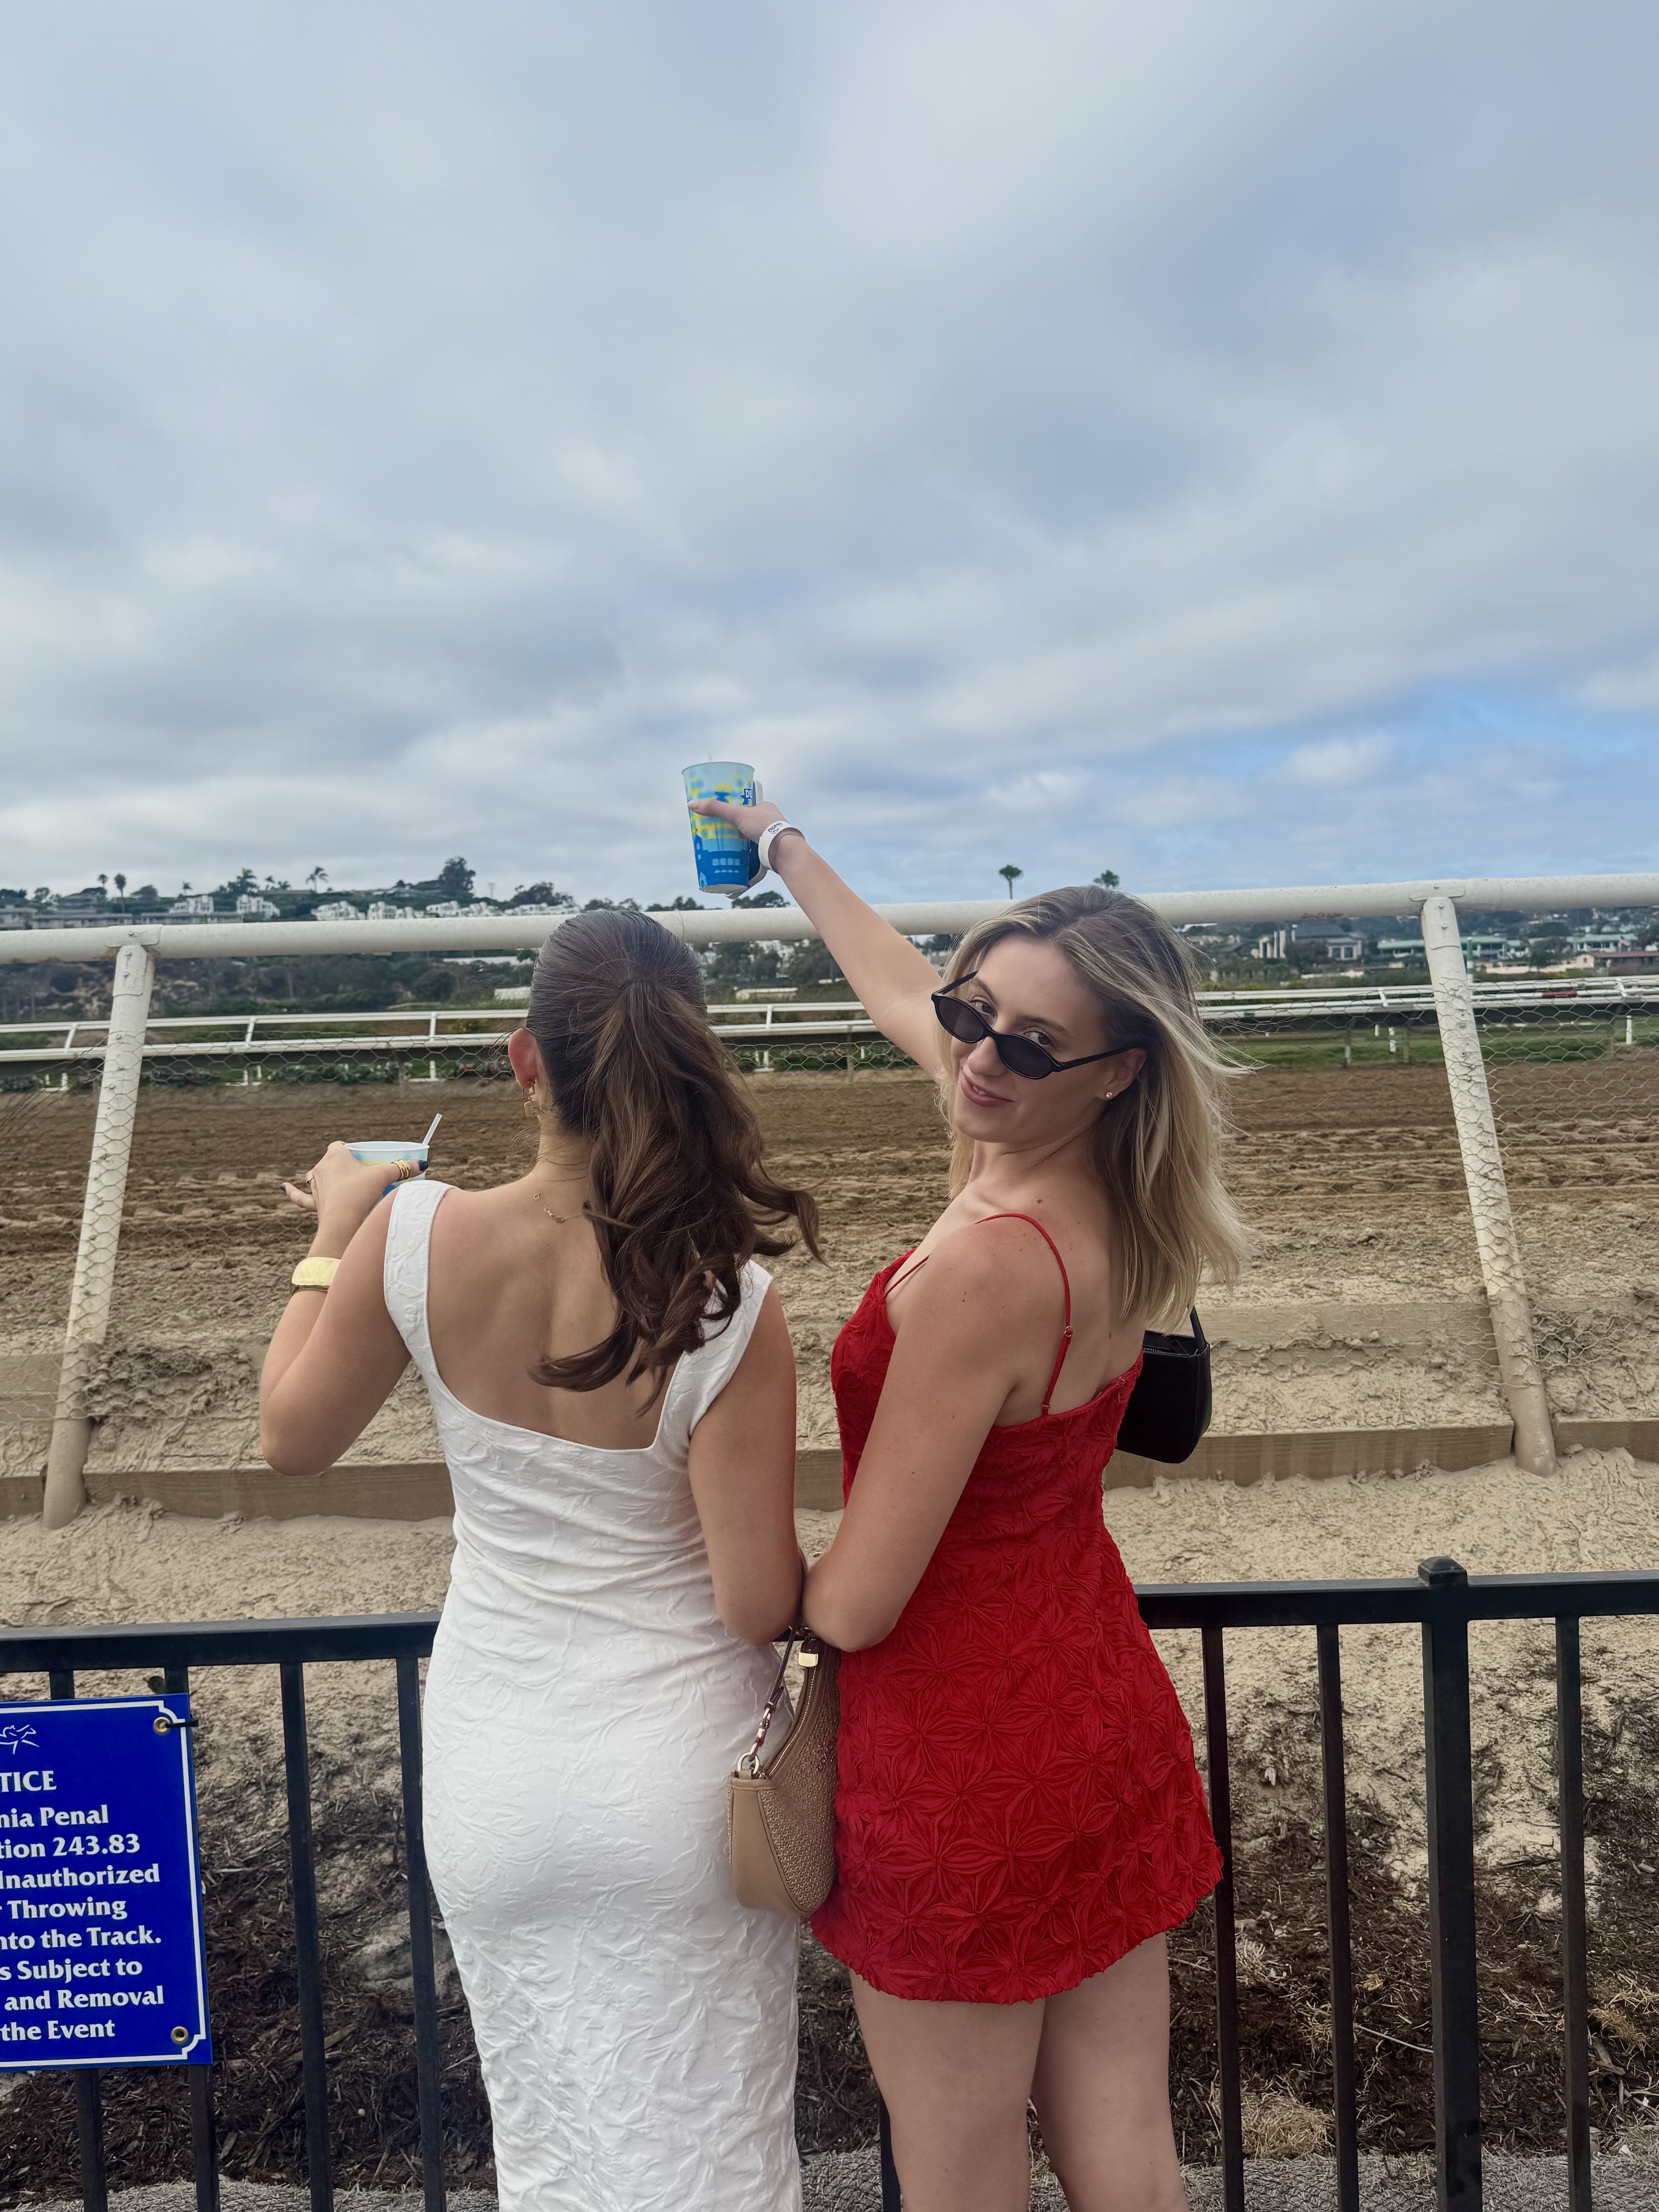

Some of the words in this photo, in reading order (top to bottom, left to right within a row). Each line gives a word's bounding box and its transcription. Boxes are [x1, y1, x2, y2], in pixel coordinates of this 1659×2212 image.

[0, 1770, 57, 1792] TICE
[39, 1804, 109, 1826] Penal
[53, 1833, 140, 1856] 243.83
[0, 1863, 160, 1889] nauthorized
[7, 1896, 128, 1920] Throwing
[40, 1929, 82, 1948] the
[86, 1925, 161, 1946] Track.
[17, 1958, 110, 1983] Subject
[115, 1958, 143, 1976] to
[4, 1990, 51, 2011] and
[57, 1985, 164, 2009] Removal
[0, 2022, 42, 2041] the
[47, 2020, 115, 2039] Event
